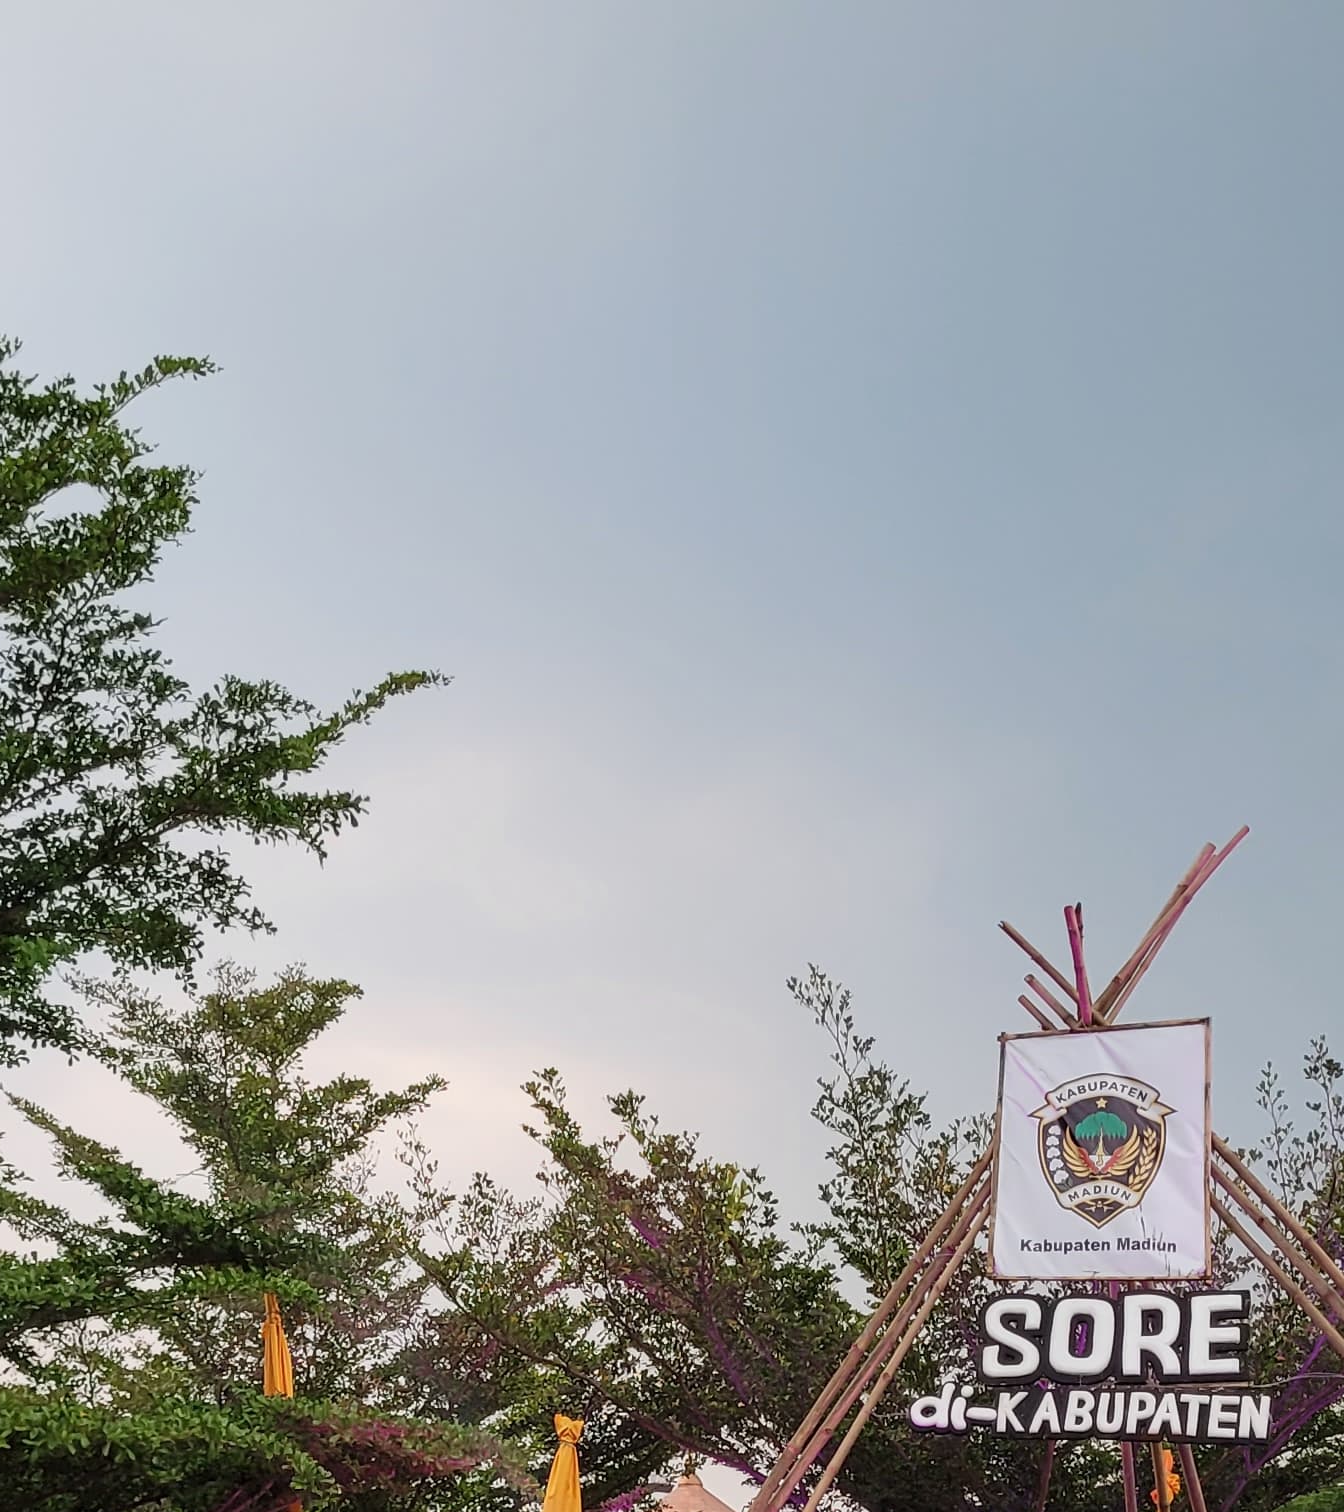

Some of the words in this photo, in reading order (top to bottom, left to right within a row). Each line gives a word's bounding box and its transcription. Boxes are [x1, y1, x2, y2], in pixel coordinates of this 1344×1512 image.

[1056, 1080, 1149, 1103] KABUPATEN
[1067, 1187, 1132, 1202] MADIUN
[1020, 1237, 1111, 1256] Kabupaten
[1116, 1237, 1177, 1253] Madiun
[982, 1295, 1244, 1378] SORE
[909, 1384, 1271, 1439] di-KABUPATEN
